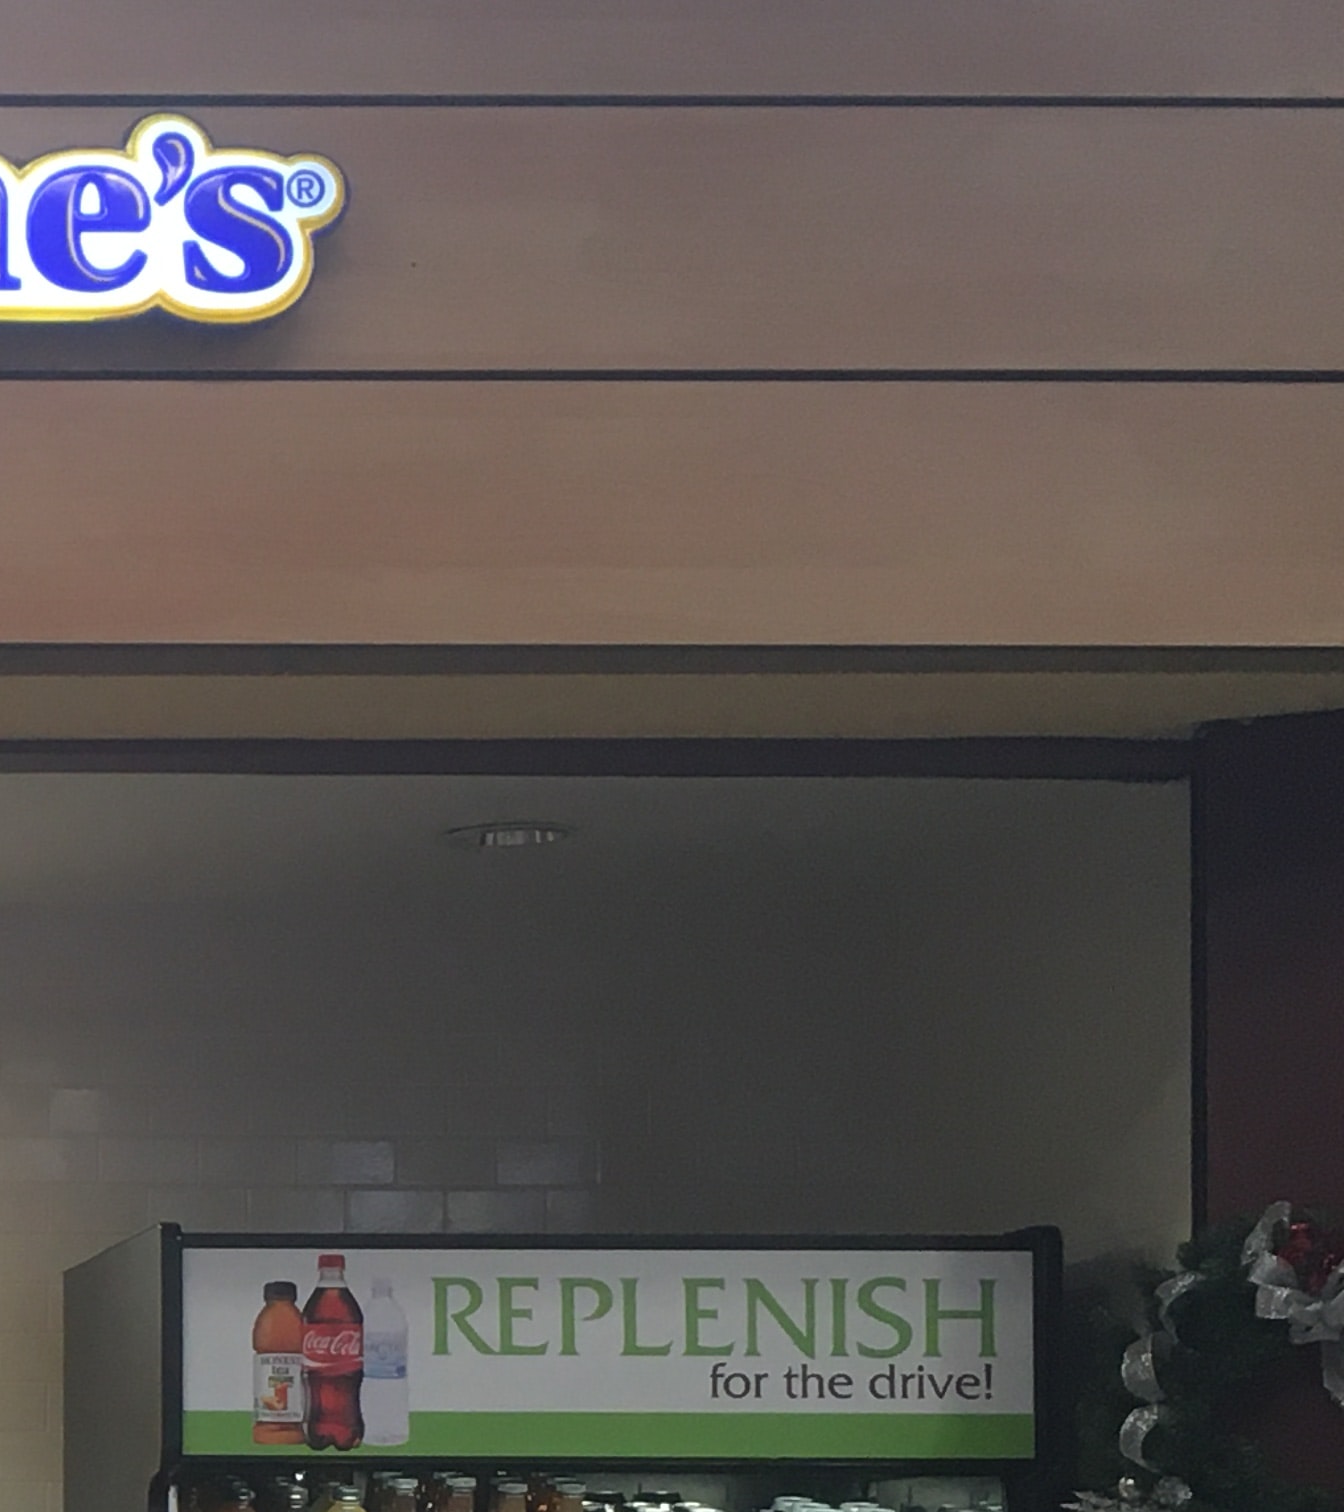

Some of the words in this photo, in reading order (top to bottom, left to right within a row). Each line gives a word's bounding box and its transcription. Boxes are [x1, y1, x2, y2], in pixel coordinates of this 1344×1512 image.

[430, 1275, 999, 1359] REPLENISH
[710, 1362, 752, 1401] for
[784, 1362, 855, 1401] the
[868, 1362, 994, 1402] drive!
